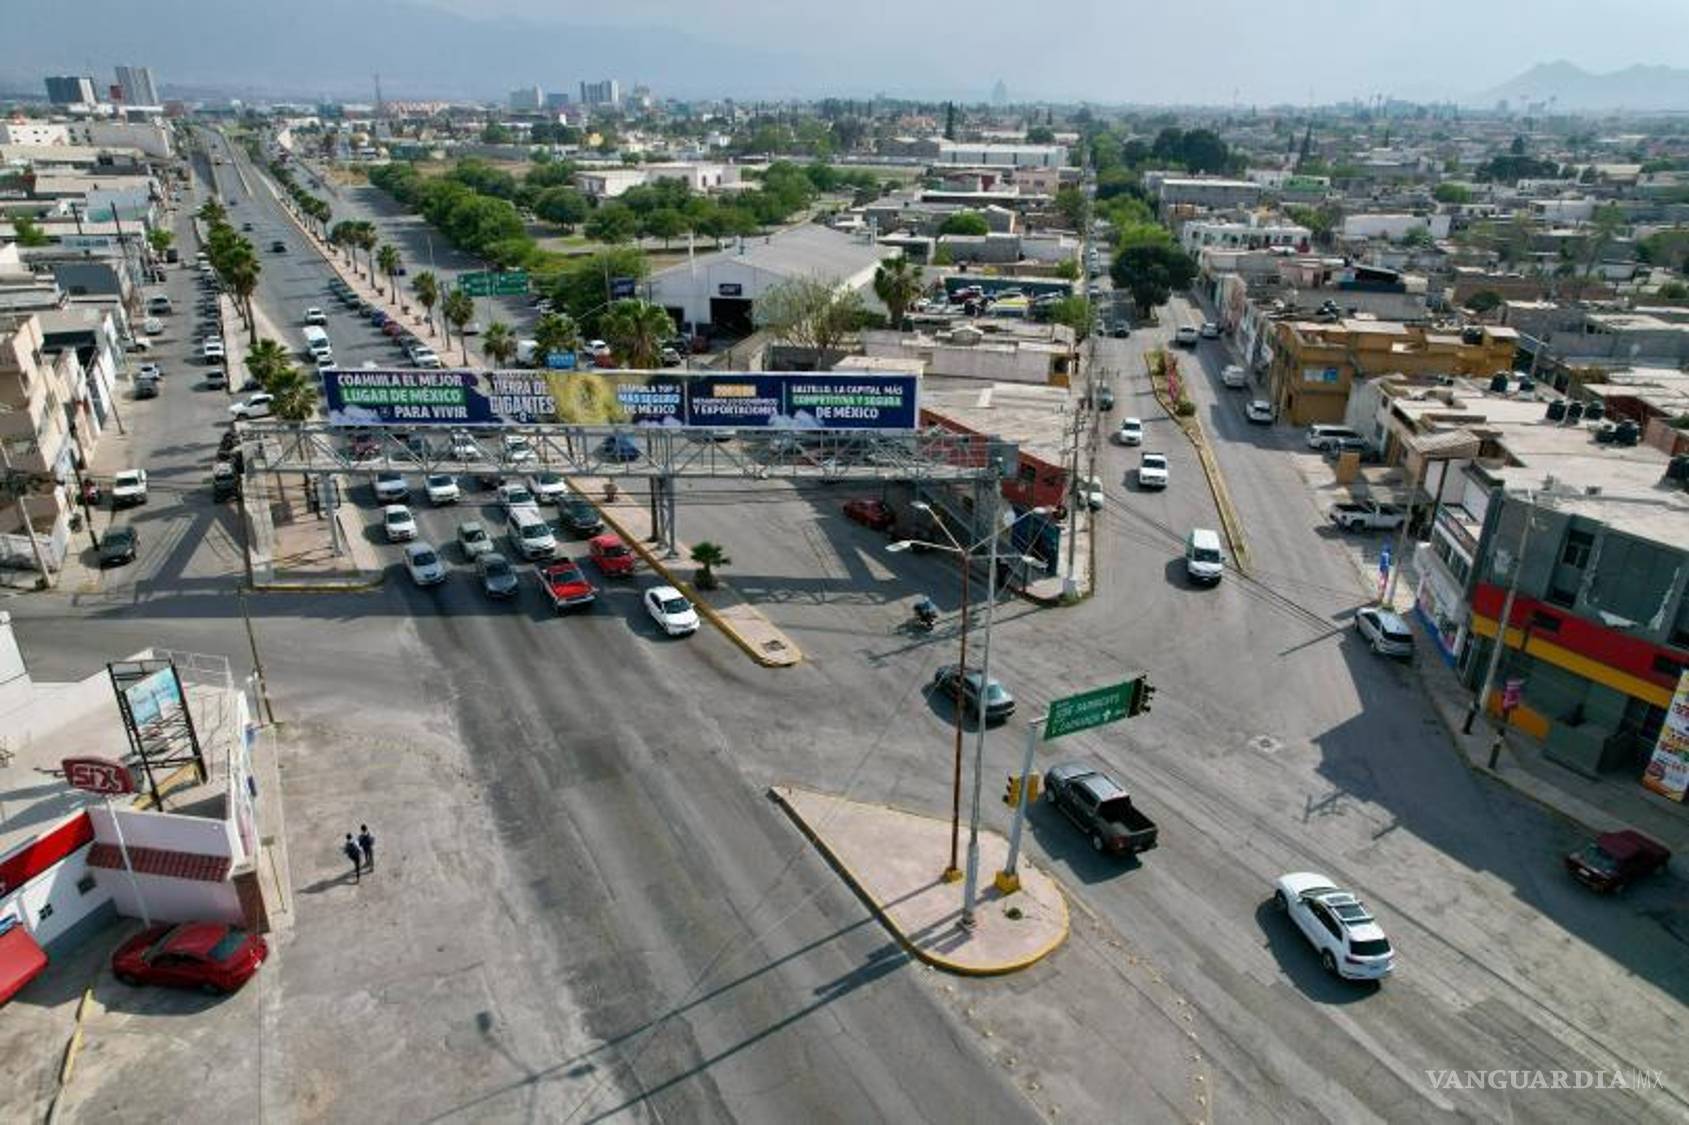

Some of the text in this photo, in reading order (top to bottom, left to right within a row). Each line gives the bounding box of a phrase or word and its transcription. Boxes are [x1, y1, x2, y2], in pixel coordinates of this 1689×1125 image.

[337, 374, 463, 387] COAHUILA EL MEJOR
[534, 380, 548, 395] DE
[834, 384, 845, 394] LA
[847, 384, 881, 395] CAPITAL
[884, 384, 903, 395] MÁS
[343, 387, 461, 402] LUGAR DE MÉXICO
[489, 396, 555, 414] GIGANTES
[624, 403, 676, 414] DE MÉXICO
[394, 406, 468, 418] PARA VIVIR
[815, 406, 879, 419] DE MÉXICO
